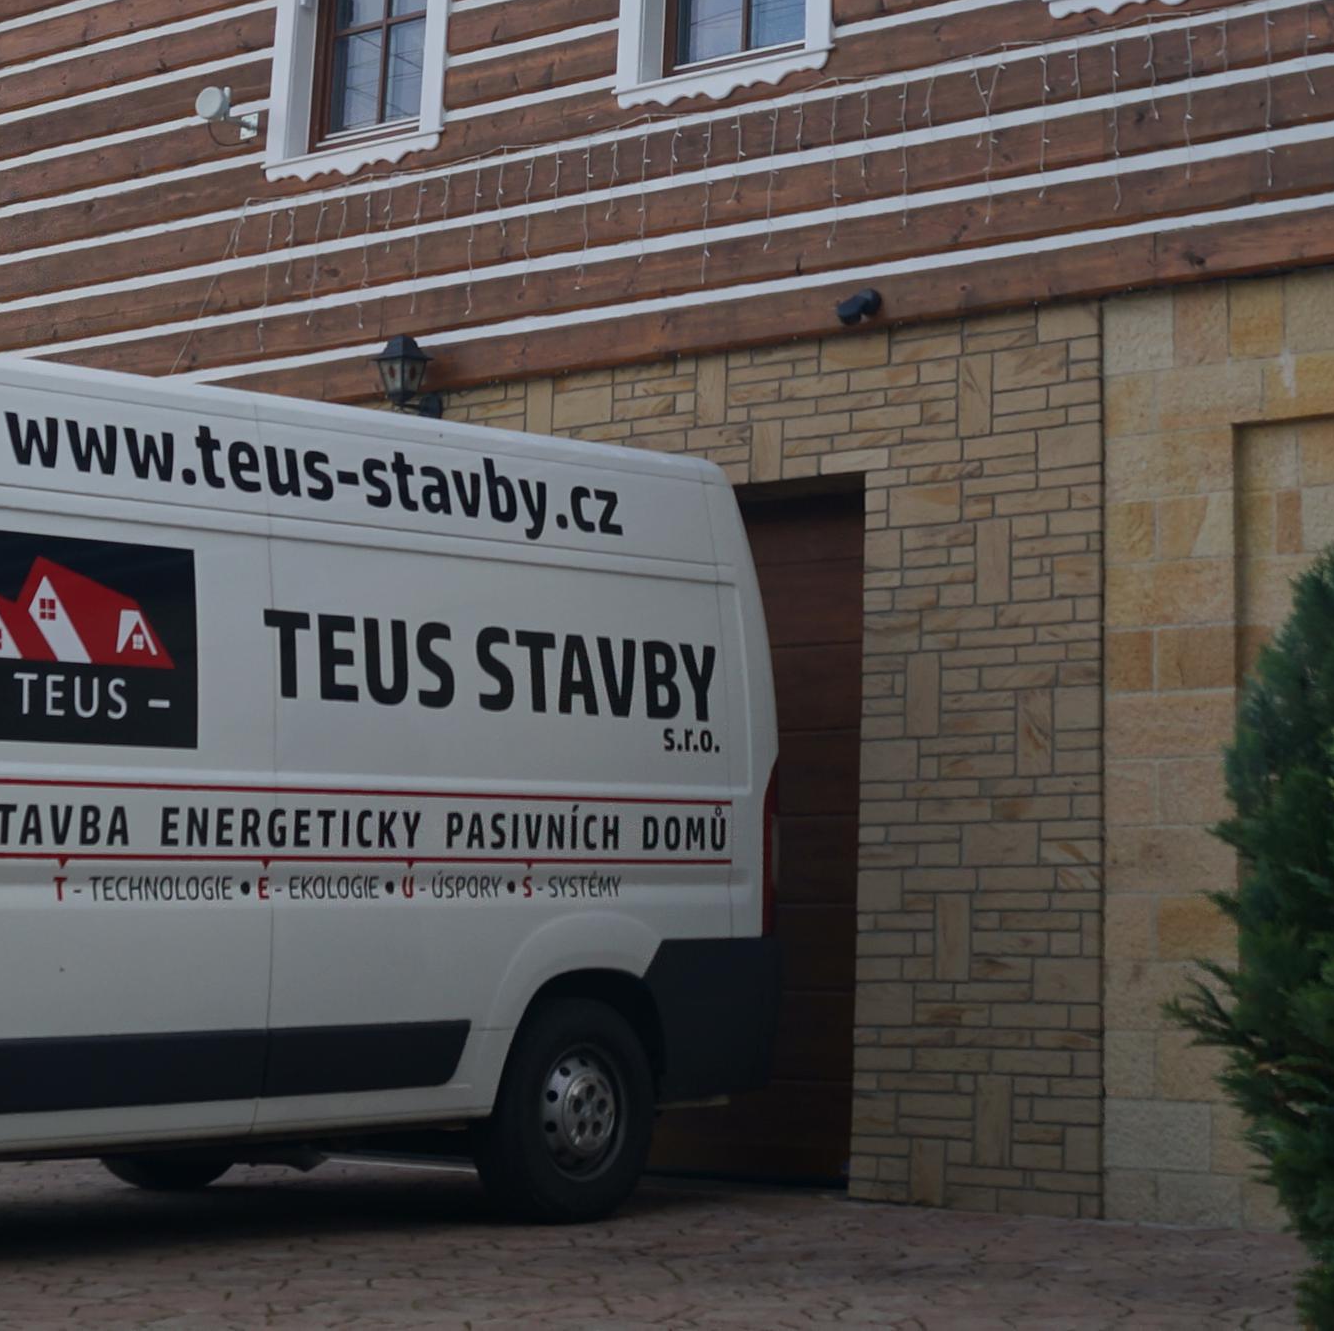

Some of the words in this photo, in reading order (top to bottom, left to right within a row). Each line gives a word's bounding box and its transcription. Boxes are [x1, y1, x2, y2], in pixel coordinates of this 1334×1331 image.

[4, 410, 623, 539] www.teus-stavby.cz
[263, 608, 454, 709] TEUS
[476, 626, 716, 722] STAVBY
[13, 672, 127, 719] TEUS
[663, 726, 721, 753] s.r.o.
[160, 806, 421, 848] ENERGETICKY
[446, 805, 619, 851] PASIVNÍCH
[642, 806, 727, 852] DOMŮ
[89, 876, 233, 901] TECHNOLOGIE
[288, 875, 380, 899] EKOLOGIE
[432, 871, 500, 899] ÚSPORY
[548, 871, 621, 898] SYSTÉMY
